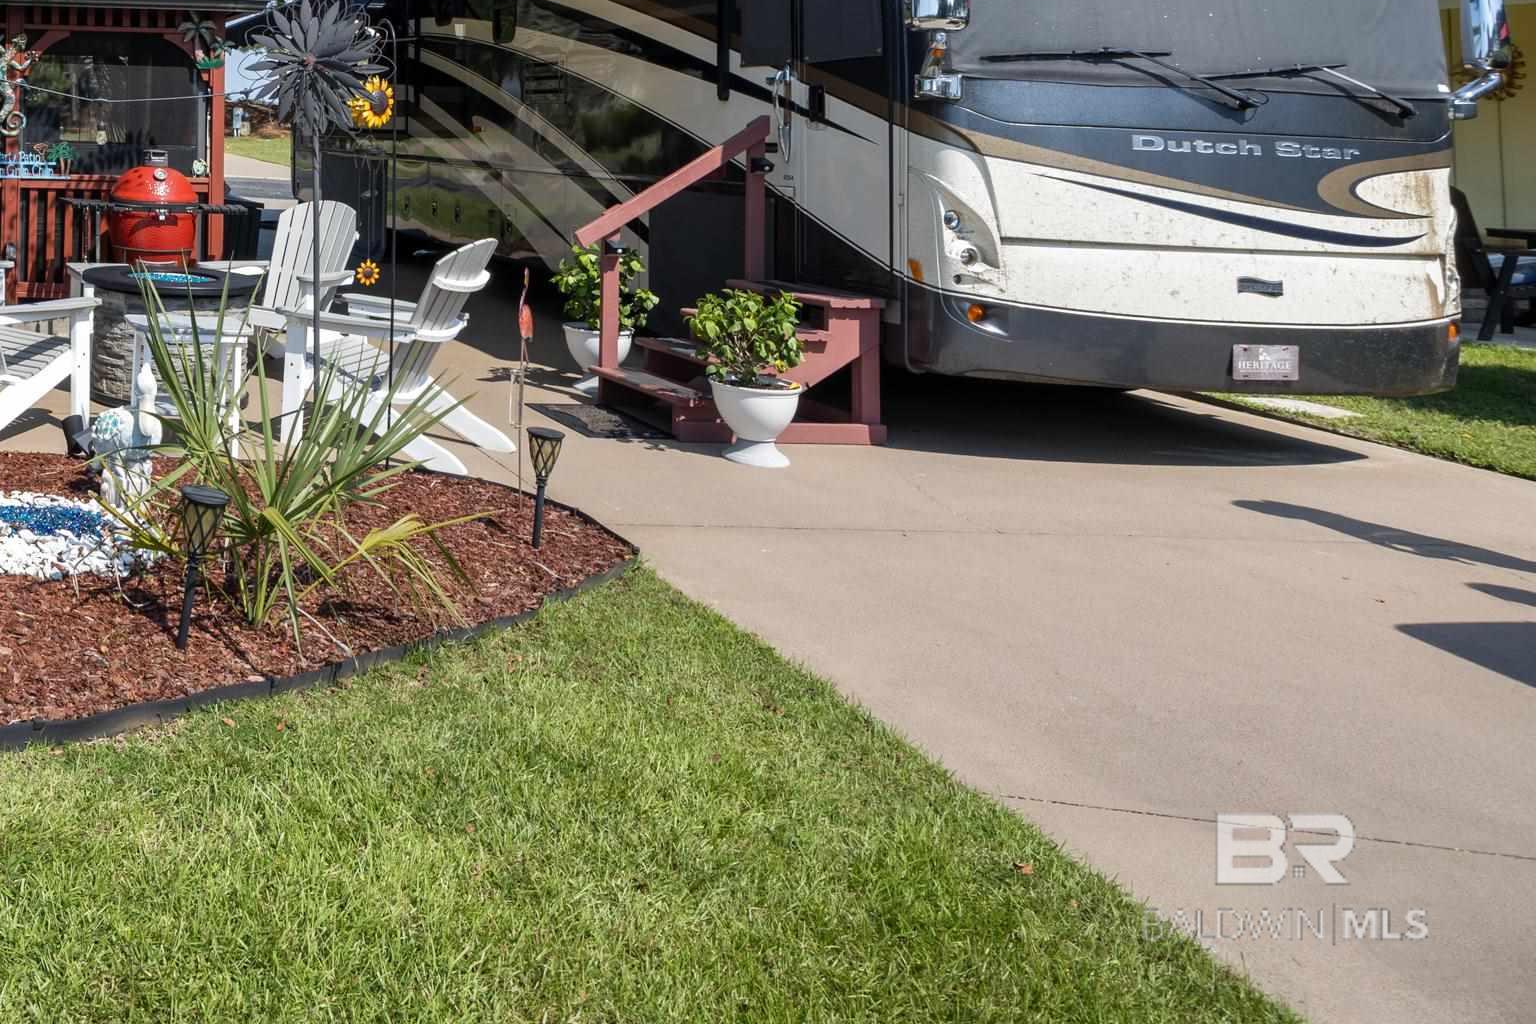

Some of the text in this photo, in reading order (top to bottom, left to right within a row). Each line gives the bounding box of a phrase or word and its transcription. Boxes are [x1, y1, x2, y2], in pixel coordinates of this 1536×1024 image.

[1131, 134, 1361, 160] Dutch Star
[1238, 360, 1291, 369] HERITAGE
